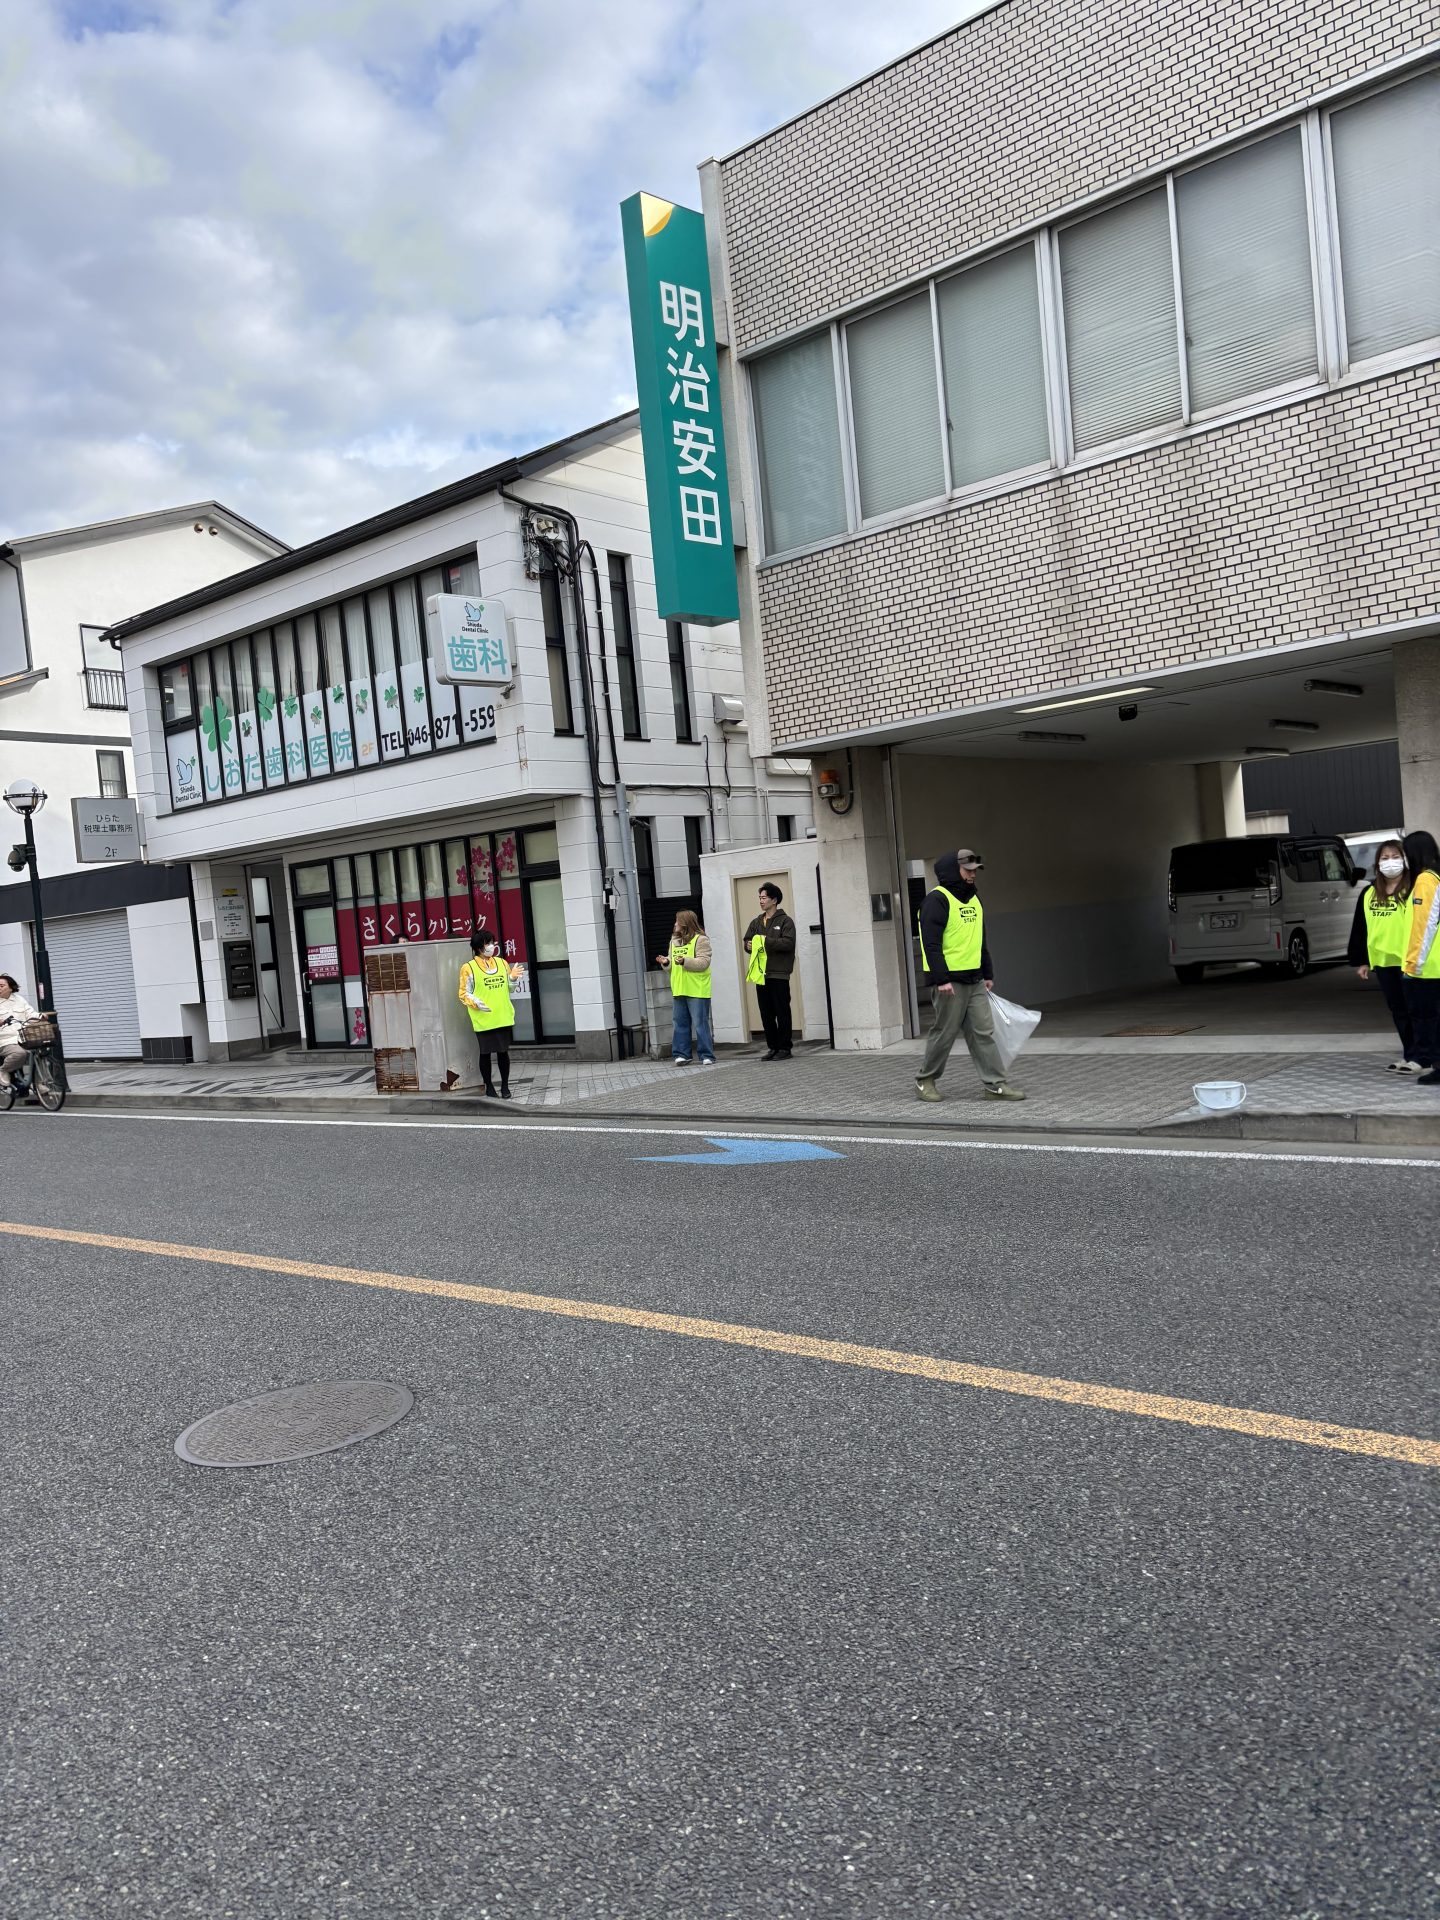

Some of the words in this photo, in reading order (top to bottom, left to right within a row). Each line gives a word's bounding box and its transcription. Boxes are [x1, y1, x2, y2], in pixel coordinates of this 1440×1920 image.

[659, 280, 723, 546] 明治安田
[447, 635, 508, 675] 歯科
[205, 728, 353, 792] しおだ歯科医院
[361, 742, 375, 757] 2F
[84, 824, 133, 833] 税理士事務所
[96, 814, 120, 823] ひらた
[104, 846, 118, 858] 2F
[362, 912, 487, 941] さくらクリニック
